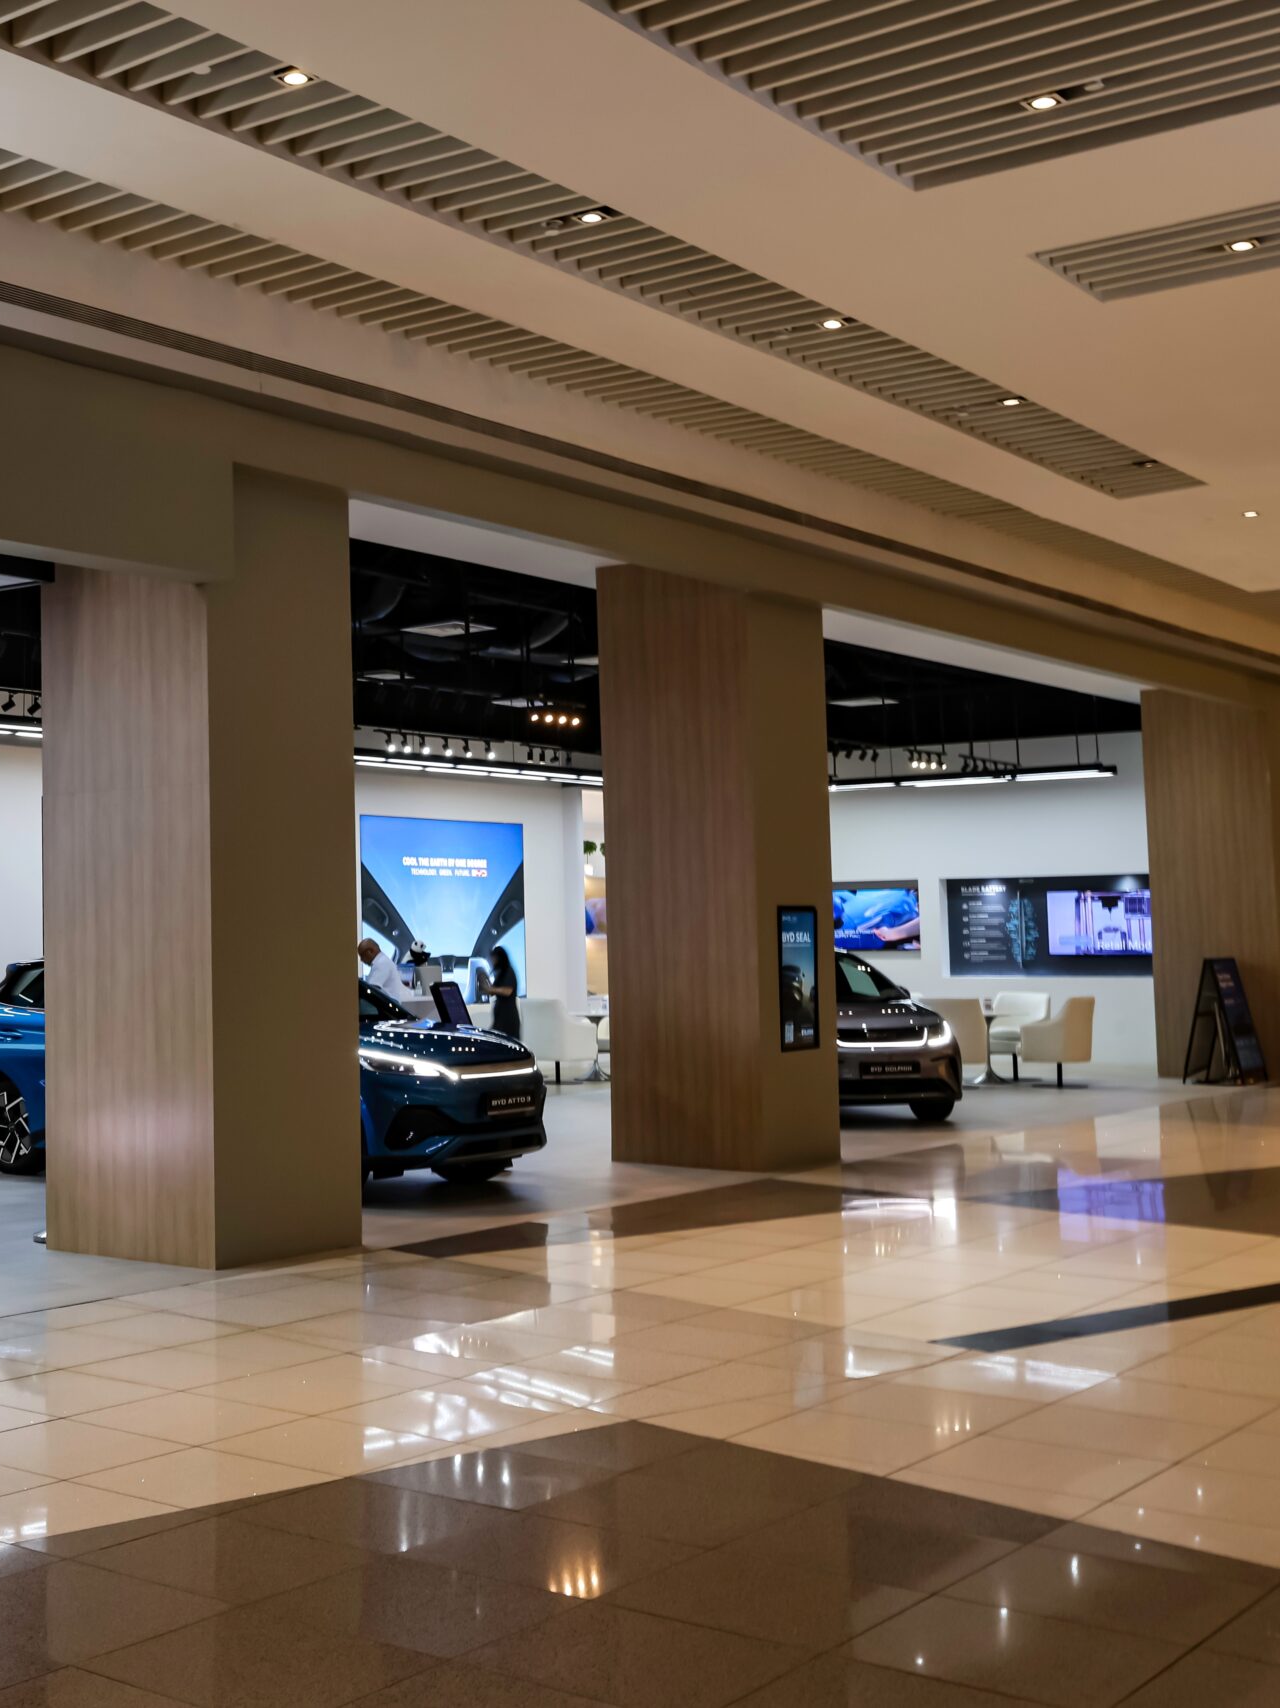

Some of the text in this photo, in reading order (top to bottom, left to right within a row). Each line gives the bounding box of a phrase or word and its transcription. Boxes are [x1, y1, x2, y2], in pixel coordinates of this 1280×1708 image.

[402, 856, 418, 866] COOL
[418, 857, 429, 866] THE
[782, 931, 811, 943] BYD SEAL
[491, 1098, 507, 1106] BYD
